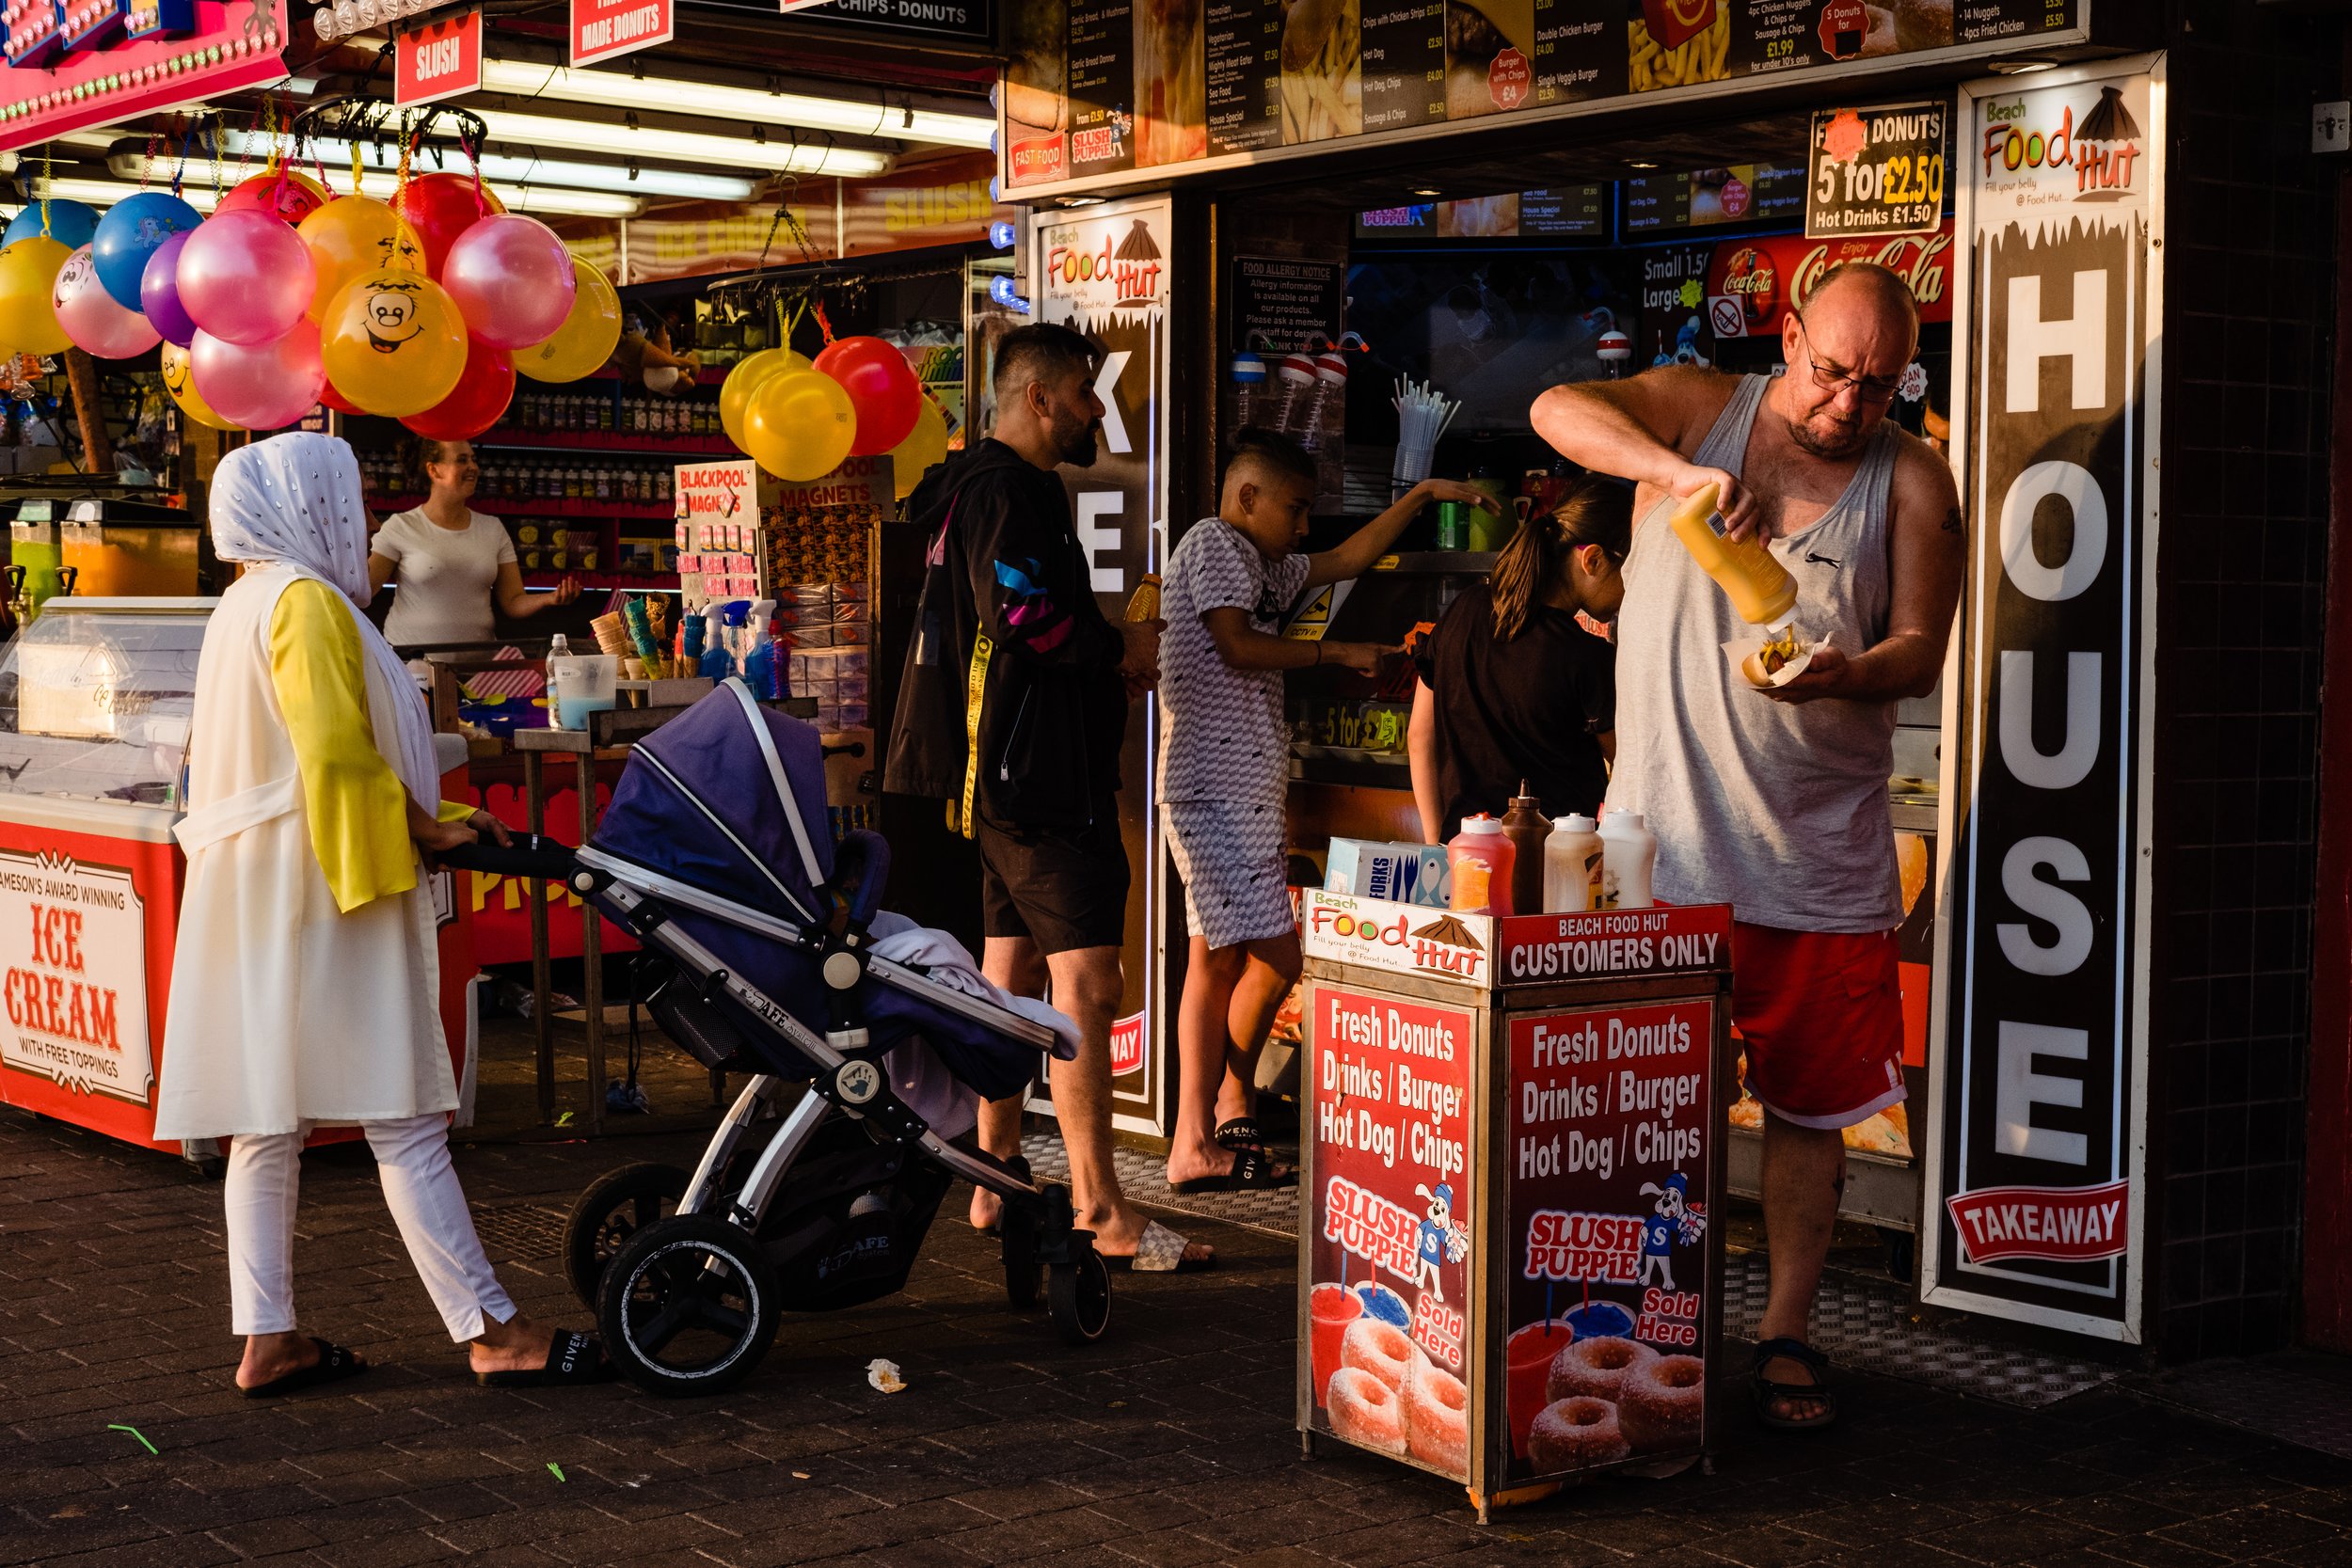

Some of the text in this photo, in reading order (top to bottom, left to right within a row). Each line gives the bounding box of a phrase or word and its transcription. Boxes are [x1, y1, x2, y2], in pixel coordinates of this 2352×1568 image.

[1362, 4, 1442, 29] Chips with Chicken Strips £3.00
[1748, 0, 1812, 17] 4pc Chicken Nuggets
[1827, 6, 1861, 20] 5 Donuts
[1963, 5, 2000, 22] 14 Nuggets
[581, 8, 659, 52] MADE DONUTS
[1764, 13, 1795, 27] & Chips or
[1838, 19, 1850, 30] for
[2045, 13, 2064, 27] £5.50
[1536, 22, 1603, 41] Double Chicken Burger
[1755, 23, 1805, 40] Sausage & Chips
[1963, 20, 2025, 41] 4pcs Fried Chicken
[1428, 37, 1443, 49] £2.50
[1536, 42, 1554, 55] £4.00
[1767, 39, 1794, 58] £1.99
[416, 36, 460, 81] SLUSH
[1363, 48, 1384, 60] Hot Dog
[1498, 56, 1520, 69] Burger
[1751, 61, 1760, 71] for
[1762, 57, 1782, 69] under
[1795, 54, 1809, 67] only
[1363, 82, 1374, 92] Hot
[1387, 77, 1402, 90] Chips
[1427, 70, 1443, 82] £4.00
[1493, 69, 1525, 83] with Chips
[1537, 69, 1598, 87] Single Veggie Burger
[1502, 85, 1517, 102] £4
[1538, 88, 1555, 101] £2.50
[1076, 110, 1104, 125] from £1.50
[1364, 108, 1406, 125] Sausage & Chips
[1429, 103, 1444, 114] £2.50
[1986, 98, 2026, 122] Beach
[1872, 112, 1940, 144] DONUTS
[1073, 129, 1111, 149] SLUSH
[1983, 104, 2140, 192] Food Hut
[1015, 147, 1059, 167] FAST FOOD
[1816, 151, 1944, 204] 5 for £2.50
[1985, 177, 2037, 196] Fill your belly
[886, 178, 992, 232] SLUSH
[2016, 196, 2025, 206] @
[2026, 194, 2046, 205] Food
[1815, 204, 1931, 228] Hot Drinks £1.50
[657, 222, 697, 258] ICE
[707, 208, 806, 252] CREAM
[1050, 226, 1078, 245] Beach
[1840, 242, 1870, 256] Enjoy
[1048, 233, 1161, 300] Food Hut
[1243, 262, 1331, 278] FOOD ALLERGY NOTICE
[1250, 279, 1324, 292] Allergy information
[1644, 286, 1680, 312] Large
[1900, 369, 1920, 385] CAN
[1906, 384, 1921, 396] 90p
[680, 469, 747, 489] BLACKPOOL
[688, 494, 740, 513] MAGNS
[780, 483, 870, 507] MAGNETS
[1290, 627, 1310, 637] CCTV
[1994, 268, 2109, 1166] HOUSE
[1369, 857, 1389, 899] FORKS
[45, 879, 78, 903] AWARD
[81, 885, 125, 911] WINNING
[1315, 892, 1359, 910] Beach
[1559, 913, 1669, 937] BEACH FOOD HUT
[30, 902, 85, 971] ICE
[1311, 907, 1410, 948] Food
[1412, 939, 1485, 975] Hut
[1313, 935, 1327, 943] Fill
[1350, 941, 1370, 953] belly
[1511, 933, 1719, 977] CUSTOMERS ONLY
[4, 967, 121, 1053] CREAM
[1331, 998, 1454, 1062] Fresh Donuts
[1533, 1013, 1691, 1069] Fresh Donuts
[19, 1037, 119, 1078] WITH FREE TOPPINGS
[1323, 1049, 1464, 1125] Drinks / Burger
[1523, 1070, 1700, 1124] Drinks / Burger
[1320, 1101, 1463, 1181] Hot Dog / Chips
[1519, 1119, 1701, 1180] Hot Dog / Chips
[1329, 1180, 1419, 1251] SLUSH
[1963, 1199, 2121, 1245] TAKEAWAY
[1530, 1213, 1645, 1252] SLUSH
[1644, 1289, 1700, 1319] Sold
[1418, 1292, 1463, 1340] Sold
[1636, 1315, 1696, 1346] Here
[562, 1332, 581, 1372] GIVEN
[1412, 1316, 1461, 1368] Here
